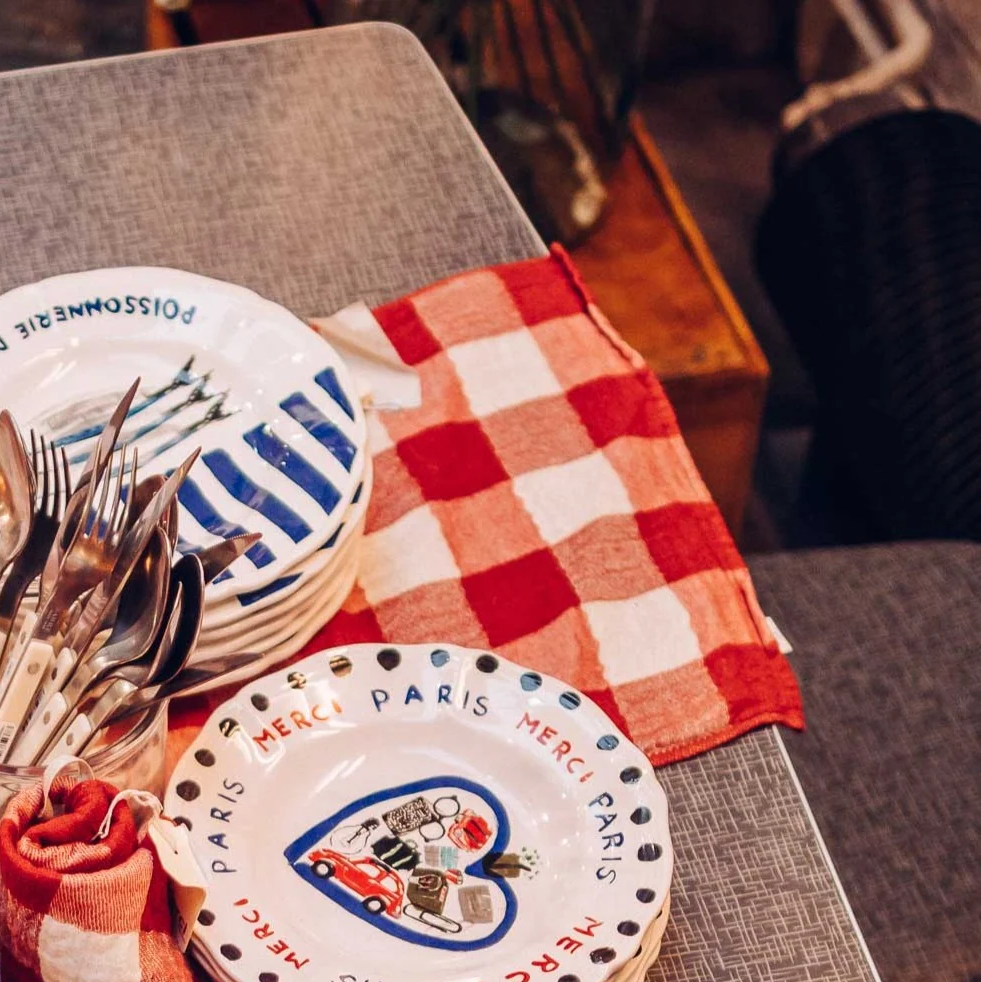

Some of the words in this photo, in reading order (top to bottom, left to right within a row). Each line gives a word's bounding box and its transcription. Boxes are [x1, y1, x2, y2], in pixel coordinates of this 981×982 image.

[14, 295, 197, 339] POISSONNERIE
[252, 699, 343, 752] MERCI
[371, 684, 490, 717] PARIS
[516, 712, 594, 783] MERCI
[208, 778, 245, 873] PARIS
[588, 791, 624, 884] PARIS
[233, 898, 310, 970] MERCI
